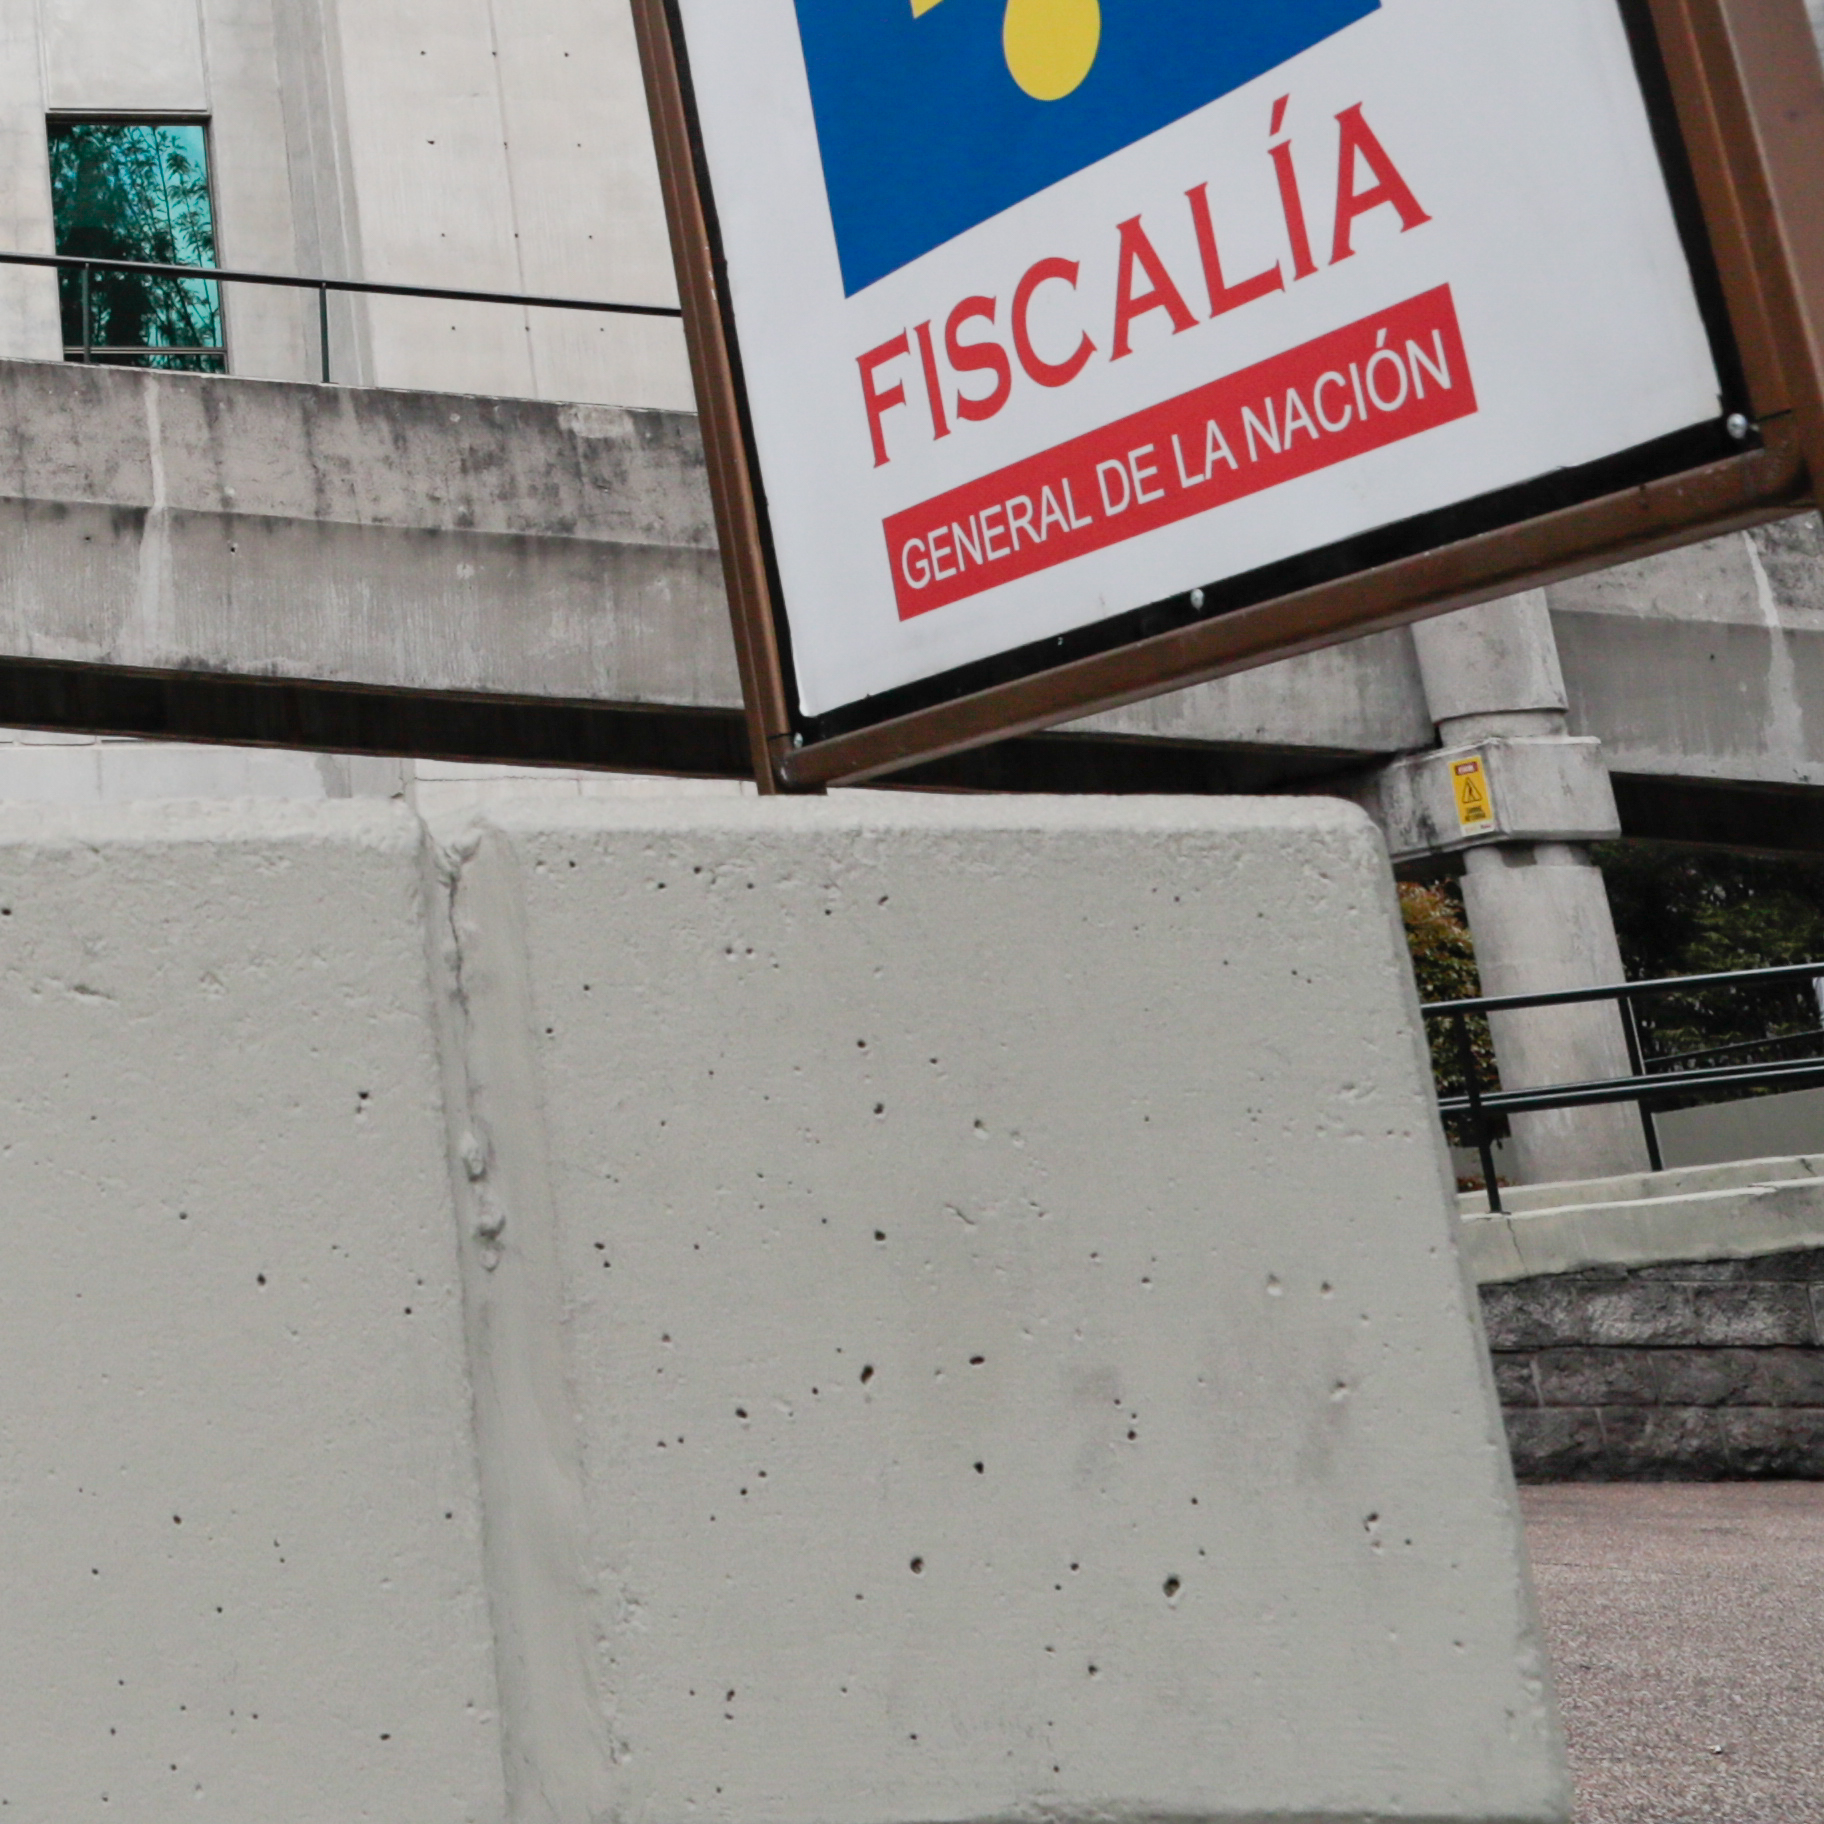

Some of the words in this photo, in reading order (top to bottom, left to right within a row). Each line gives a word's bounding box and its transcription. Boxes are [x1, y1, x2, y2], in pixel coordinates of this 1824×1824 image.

[854, 92, 1433, 469] FISCALÍA
[901, 477, 1092, 590] GENERAL
[1096, 444, 1164, 517] DE
[1171, 419, 1238, 488] LA
[1241, 328, 1451, 463] NACIÓN
